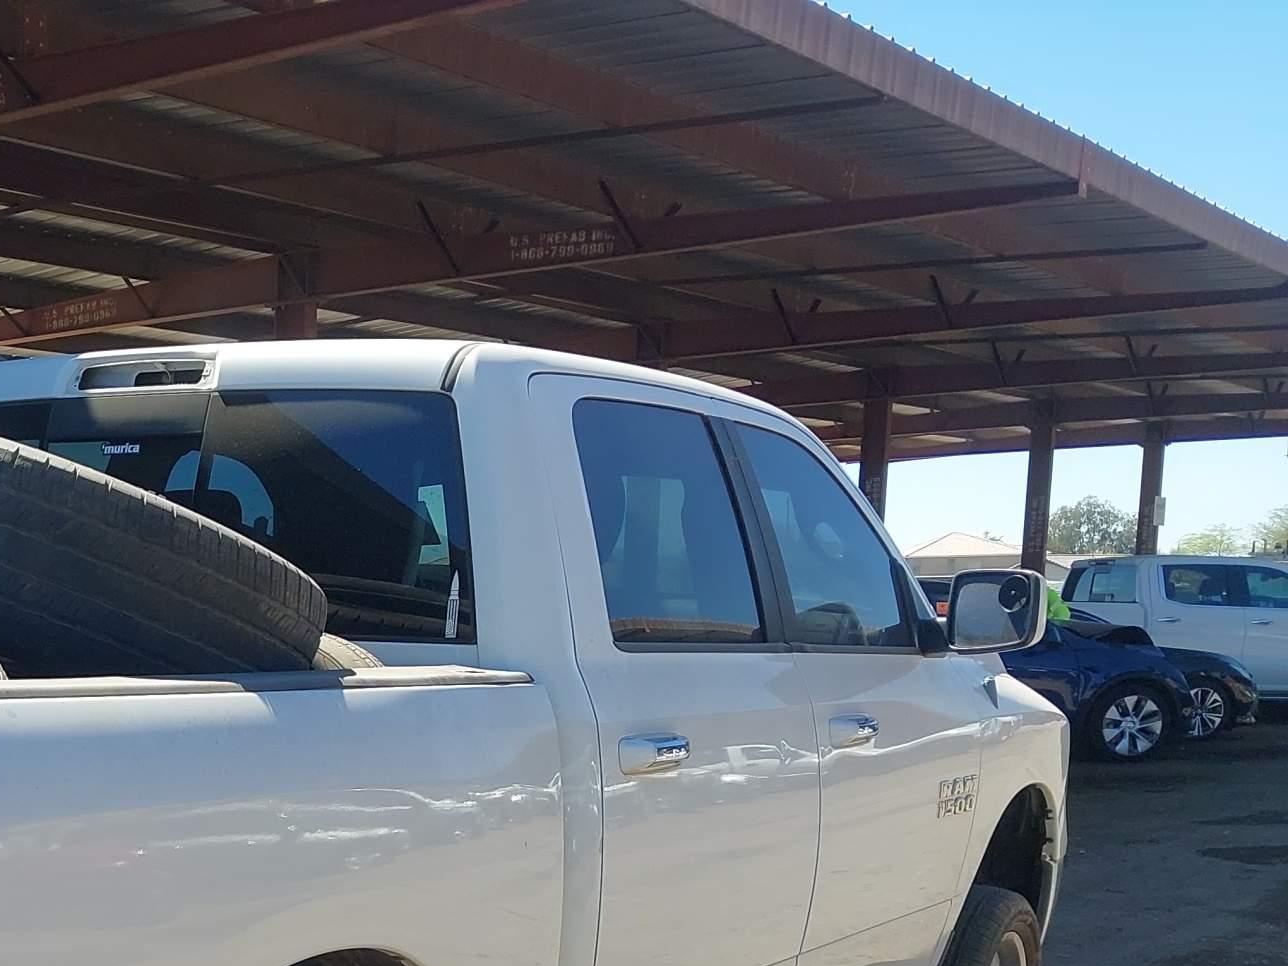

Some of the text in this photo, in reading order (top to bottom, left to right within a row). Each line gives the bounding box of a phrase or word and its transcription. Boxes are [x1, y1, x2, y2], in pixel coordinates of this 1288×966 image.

[539, 229, 587, 246] PREFAB
[939, 774, 978, 799] RAM
[937, 794, 975, 819] 1500
